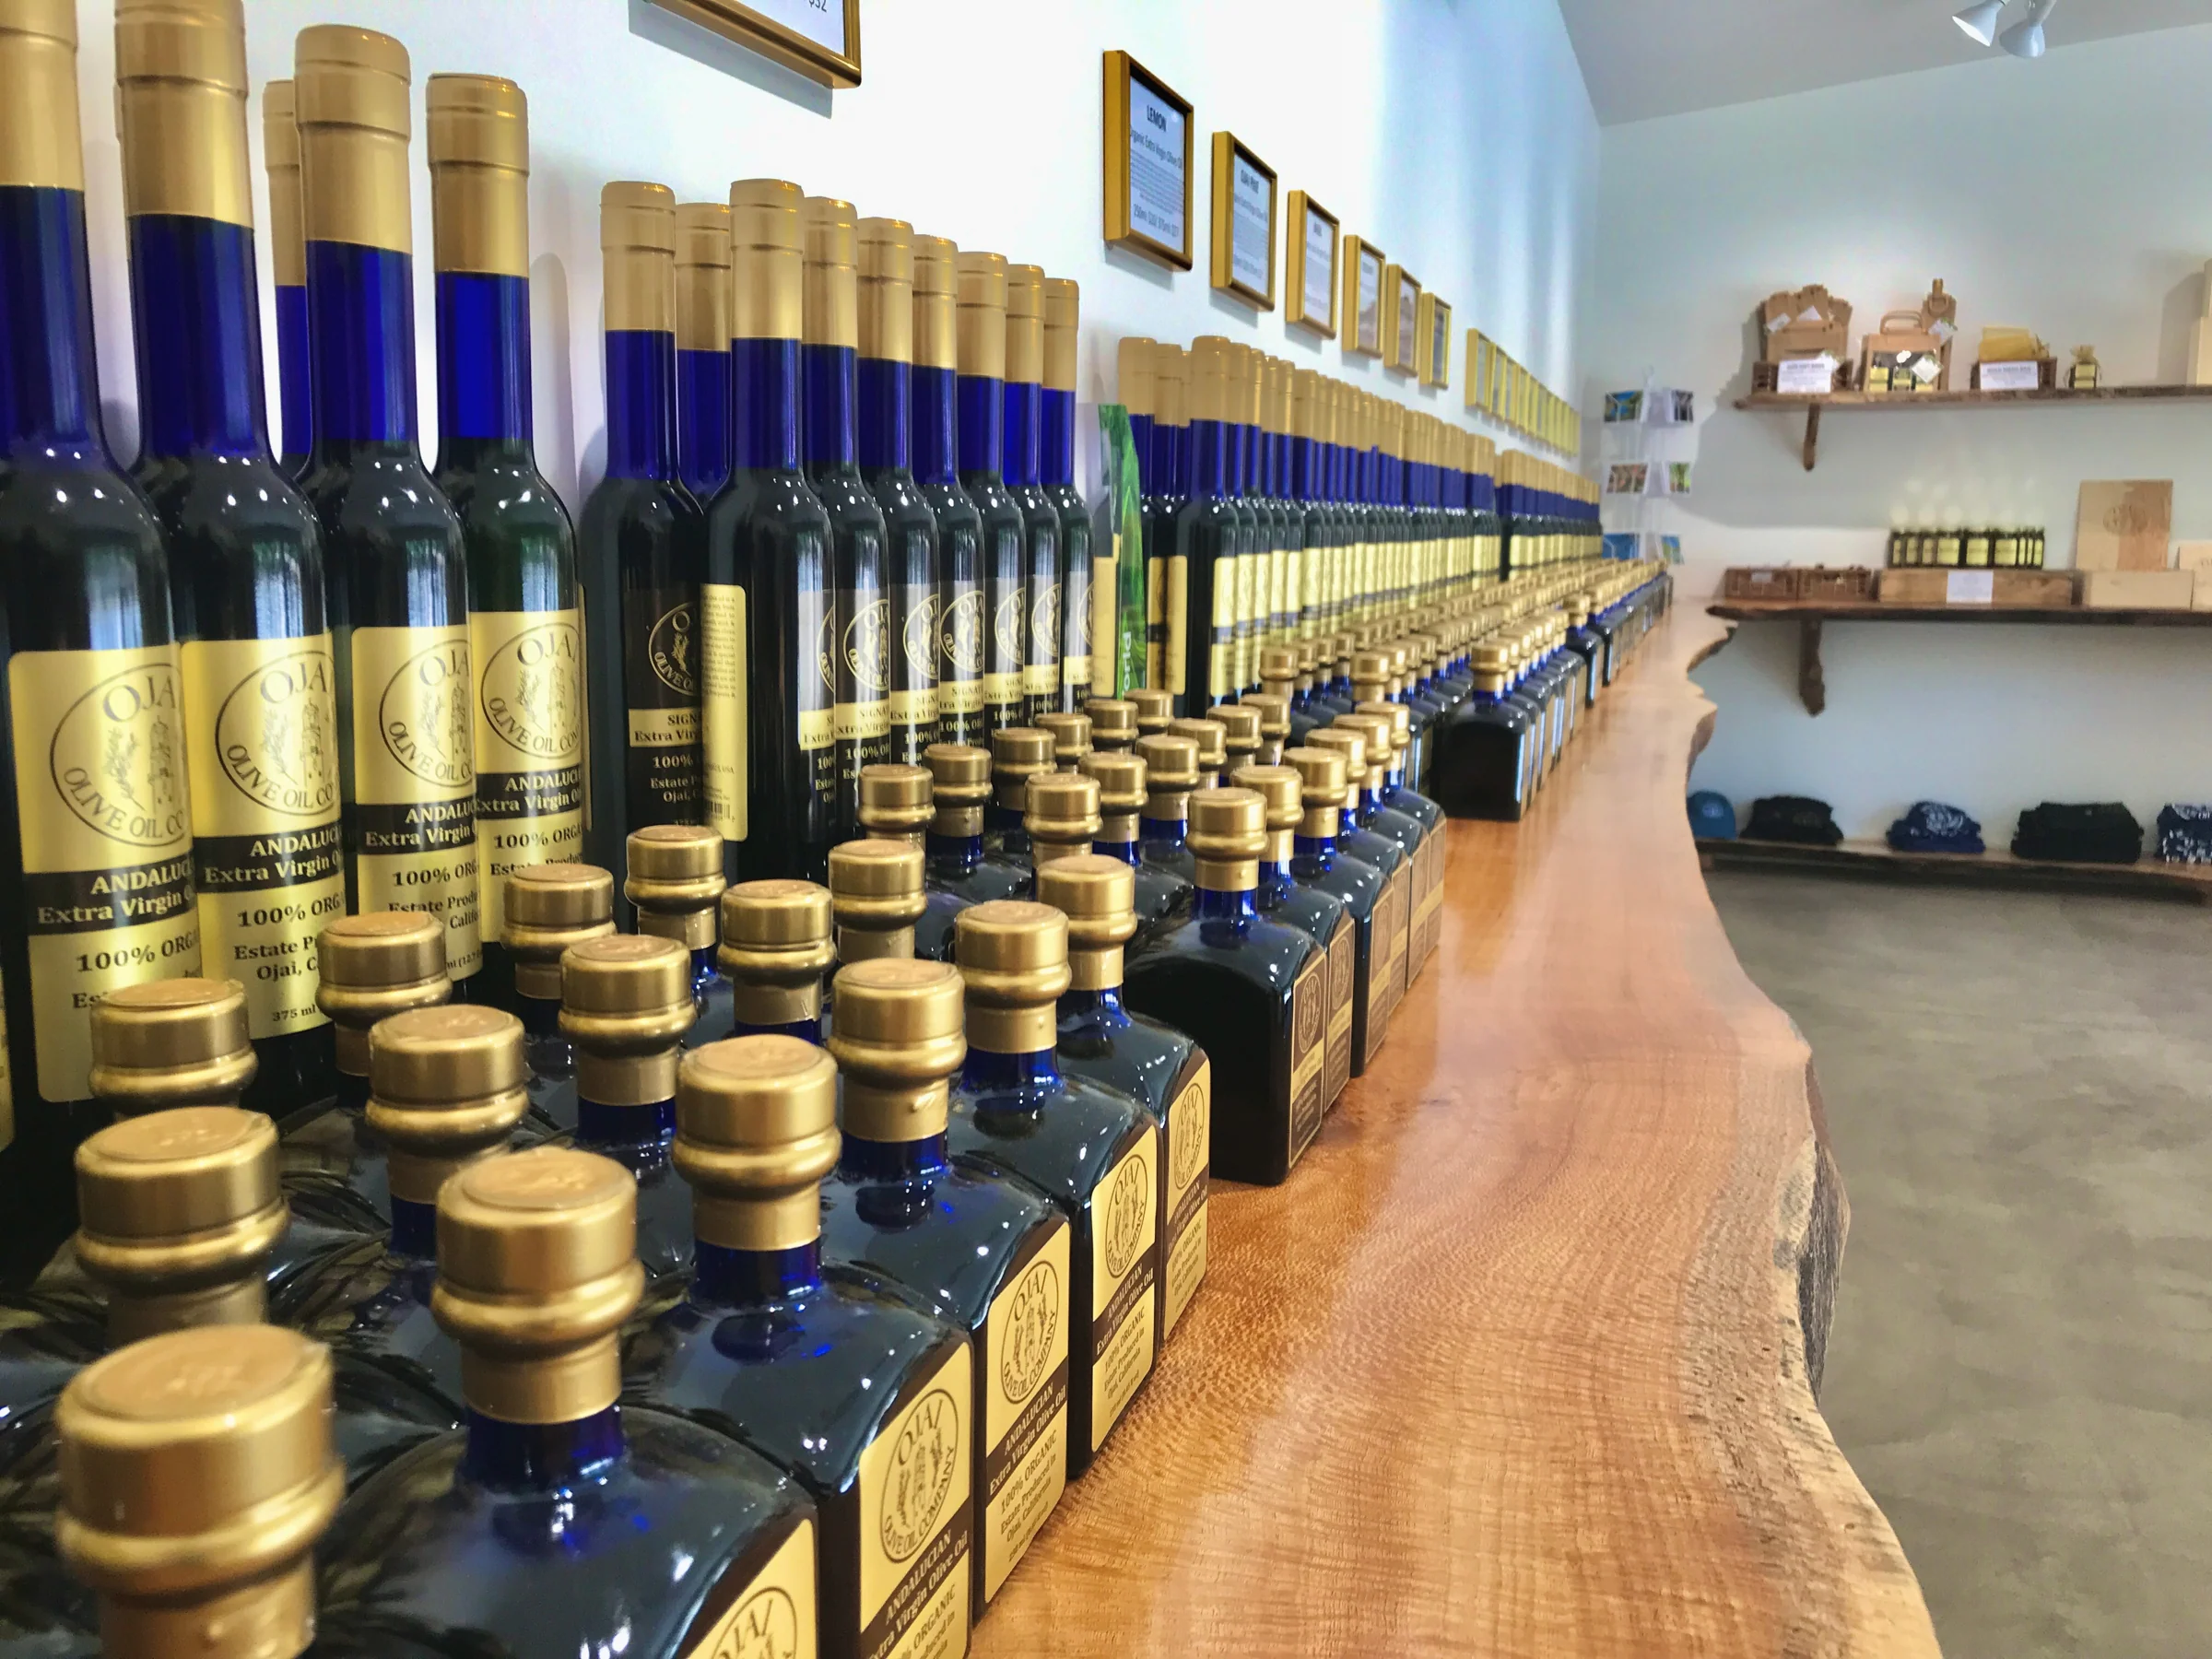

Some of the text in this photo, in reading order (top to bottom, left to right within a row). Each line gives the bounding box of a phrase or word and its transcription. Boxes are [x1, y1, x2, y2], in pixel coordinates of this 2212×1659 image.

[1146, 104, 1167, 132] LEMON
[654, 651, 683, 688] OLIVE
[488, 696, 531, 747] OLIVE
[533, 735, 558, 753] OIL
[634, 730, 673, 743] Extra
[389, 721, 433, 773] OLIVE
[435, 762, 460, 782] OIL
[653, 754, 693, 770] 100%
[227, 744, 280, 802] OLIVE
[283, 790, 313, 809] OIL
[650, 777, 688, 789] Estate
[64, 766, 127, 830] OLIVE
[129, 816, 163, 839] OIL
[524, 791, 570, 811] Virgin
[365, 823, 471, 847] Extra Virgin
[493, 831, 548, 849] 100%
[205, 853, 330, 884] Extra Virgin
[393, 865, 451, 887] 100%
[37, 905, 113, 924] Extra
[120, 890, 182, 918] Virgin
[237, 902, 306, 928] 100%
[76, 944, 156, 972] 100%
[233, 940, 299, 960] Estate
[256, 962, 302, 982] Ojai,
[272, 1007, 298, 1023] 375
[1115, 1162, 1140, 1206] OJAI
[1014, 1269, 1048, 1322] OJAI
[1097, 1267, 1154, 1356] Extra Virgin Olive Oil
[1107, 1263, 1143, 1323] ANDALUCIAN
[1030, 1310, 1056, 1385] COMPANY
[1120, 1305, 1146, 1347] ORGANIC
[898, 1398, 945, 1465] OJAI
[989, 1384, 1066, 1496] Extra Virgin Olive Oil
[1004, 1382, 1054, 1456] ANDALUCIAN
[1000, 1502, 1021, 1535] Estate
[1021, 1464, 1051, 1508] Produced
[1049, 1453, 1057, 1470] in
[1001, 1476, 1024, 1516] 100%
[1024, 1430, 1057, 1482] ORGANIC
[884, 1444, 955, 1555] OLIVE OIL COMPANY
[1022, 1476, 1052, 1522] California
[886, 1528, 952, 1626] ANDALUCIAN
[895, 1586, 927, 1632] Virgin
[928, 1553, 954, 1591] Olive
[954, 1530, 968, 1557] Oil
[913, 1583, 956, 1651] ORGANIC
